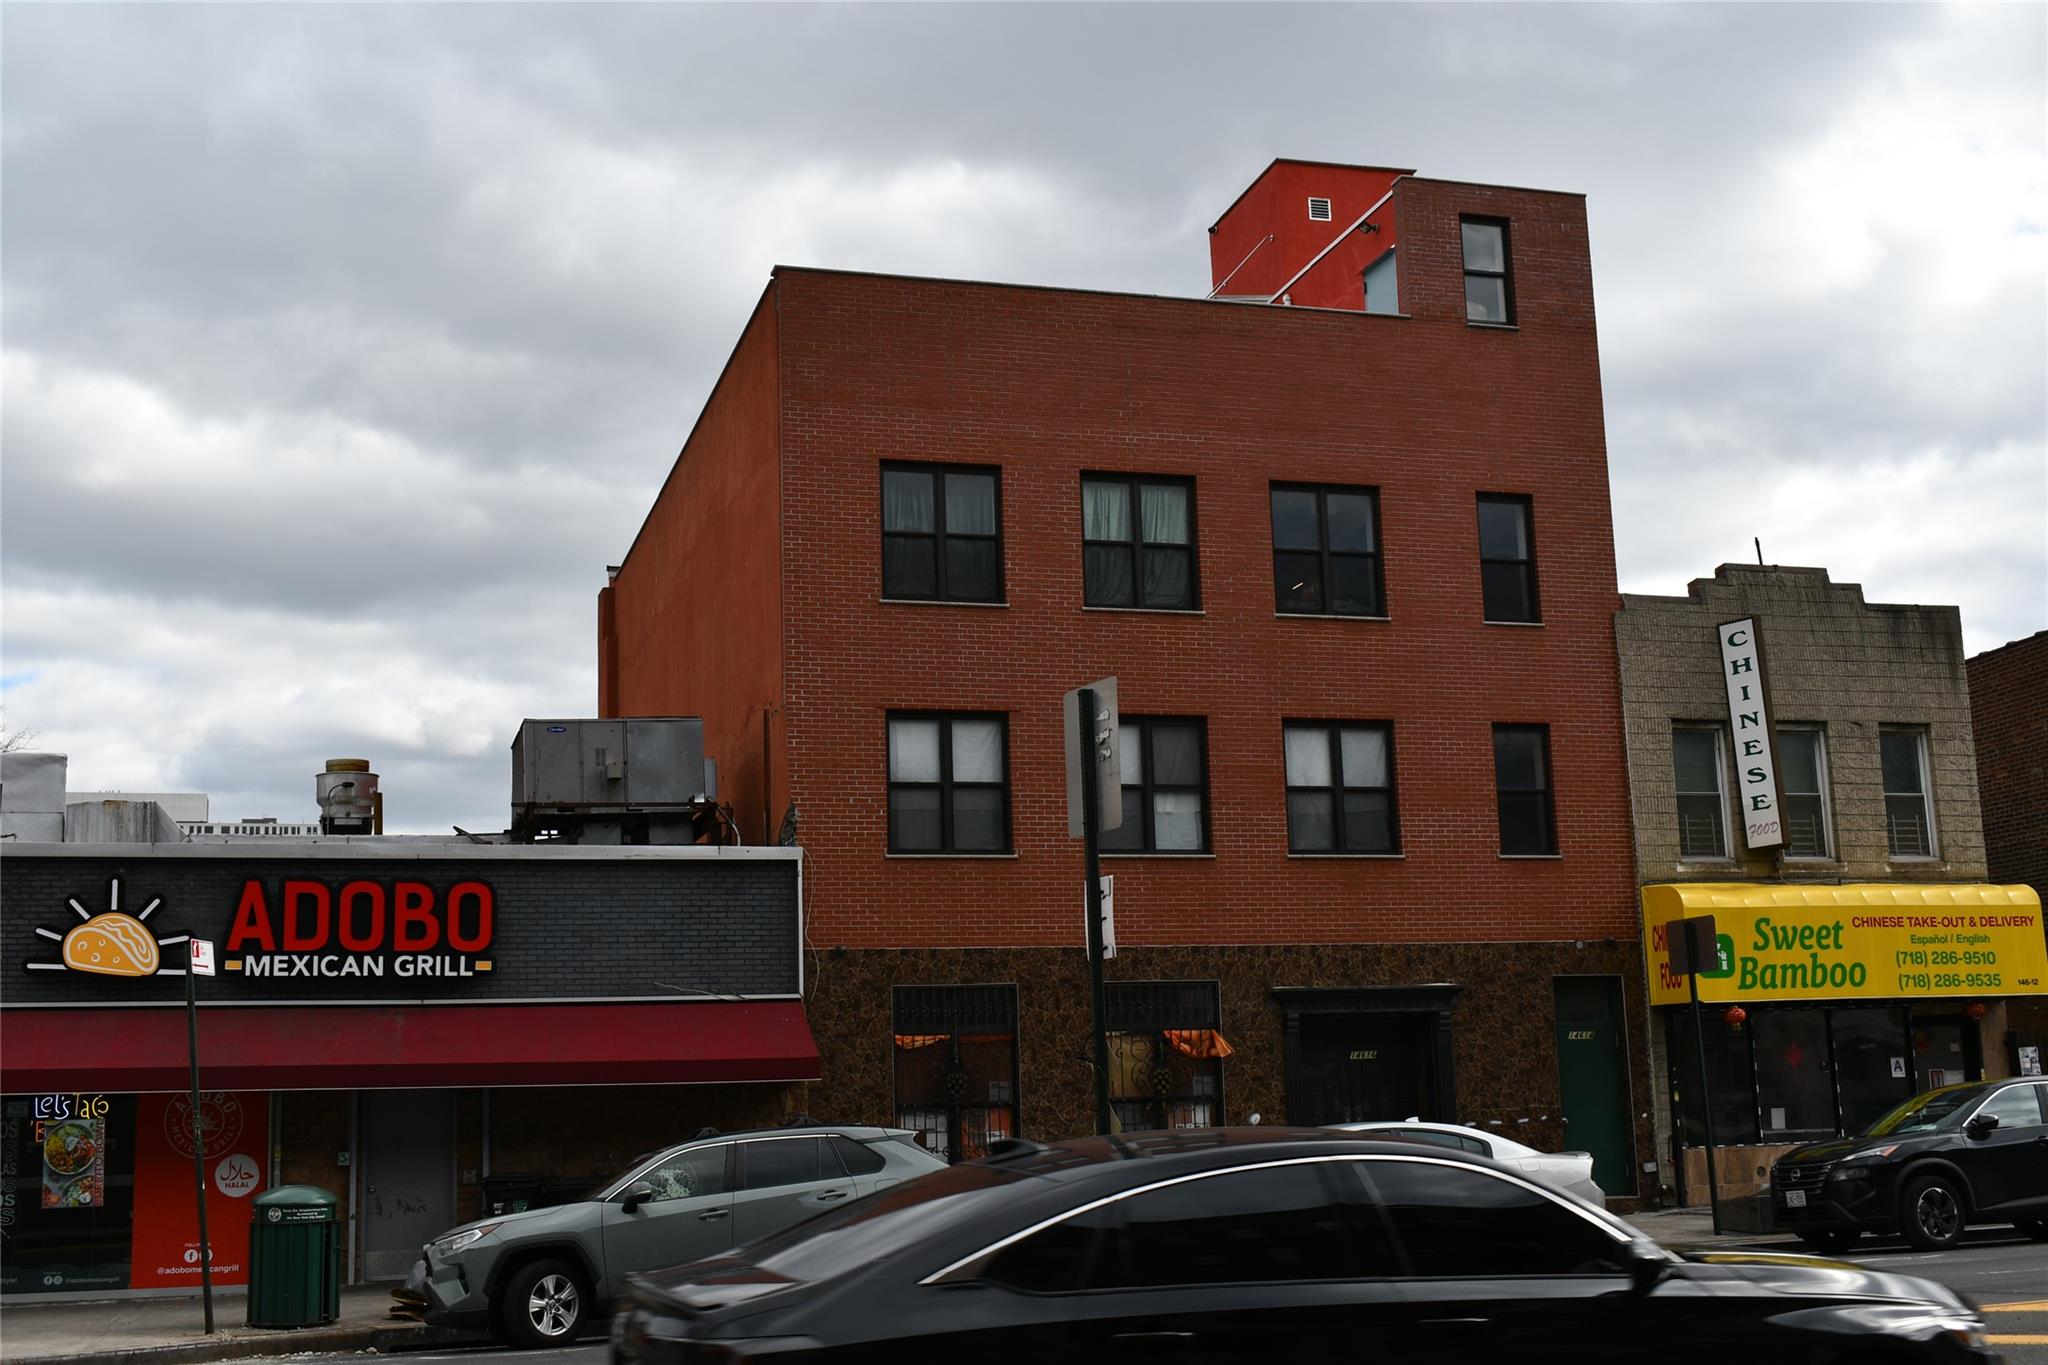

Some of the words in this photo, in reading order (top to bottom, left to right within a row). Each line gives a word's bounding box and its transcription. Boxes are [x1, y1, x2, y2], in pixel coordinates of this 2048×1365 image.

[1728, 630, 1772, 812] CHINESE
[1748, 820, 1779, 840] FOOD
[226, 880, 493, 952] ADOBO
[1852, 916, 1905, 928] CHINESE
[1907, 916, 1966, 928] TAKE-OUT
[1969, 916, 1977, 927] &
[1980, 915, 2035, 927] DELIVERY
[1753, 917, 1844, 951] Sweet
[1910, 934, 1949, 945] Español
[1956, 934, 1991, 945] English
[245, 955, 384, 977] MEXICAN
[394, 955, 474, 977] GRILL
[1896, 950, 1928, 968] (718)
[1931, 951, 1996, 966] 286-9510
[1738, 952, 1867, 990] Bamboo
[1899, 973, 1931, 991] (718)
[1934, 973, 2002, 988] 286-9535
[1894, 1060, 1903, 1072] A
[35, 1093, 71, 1120] Let's
[73, 1093, 110, 1120] Taco
[220, 1160, 254, 1181] حلال
[157, 1263, 240, 1275] @adobomecangrill
